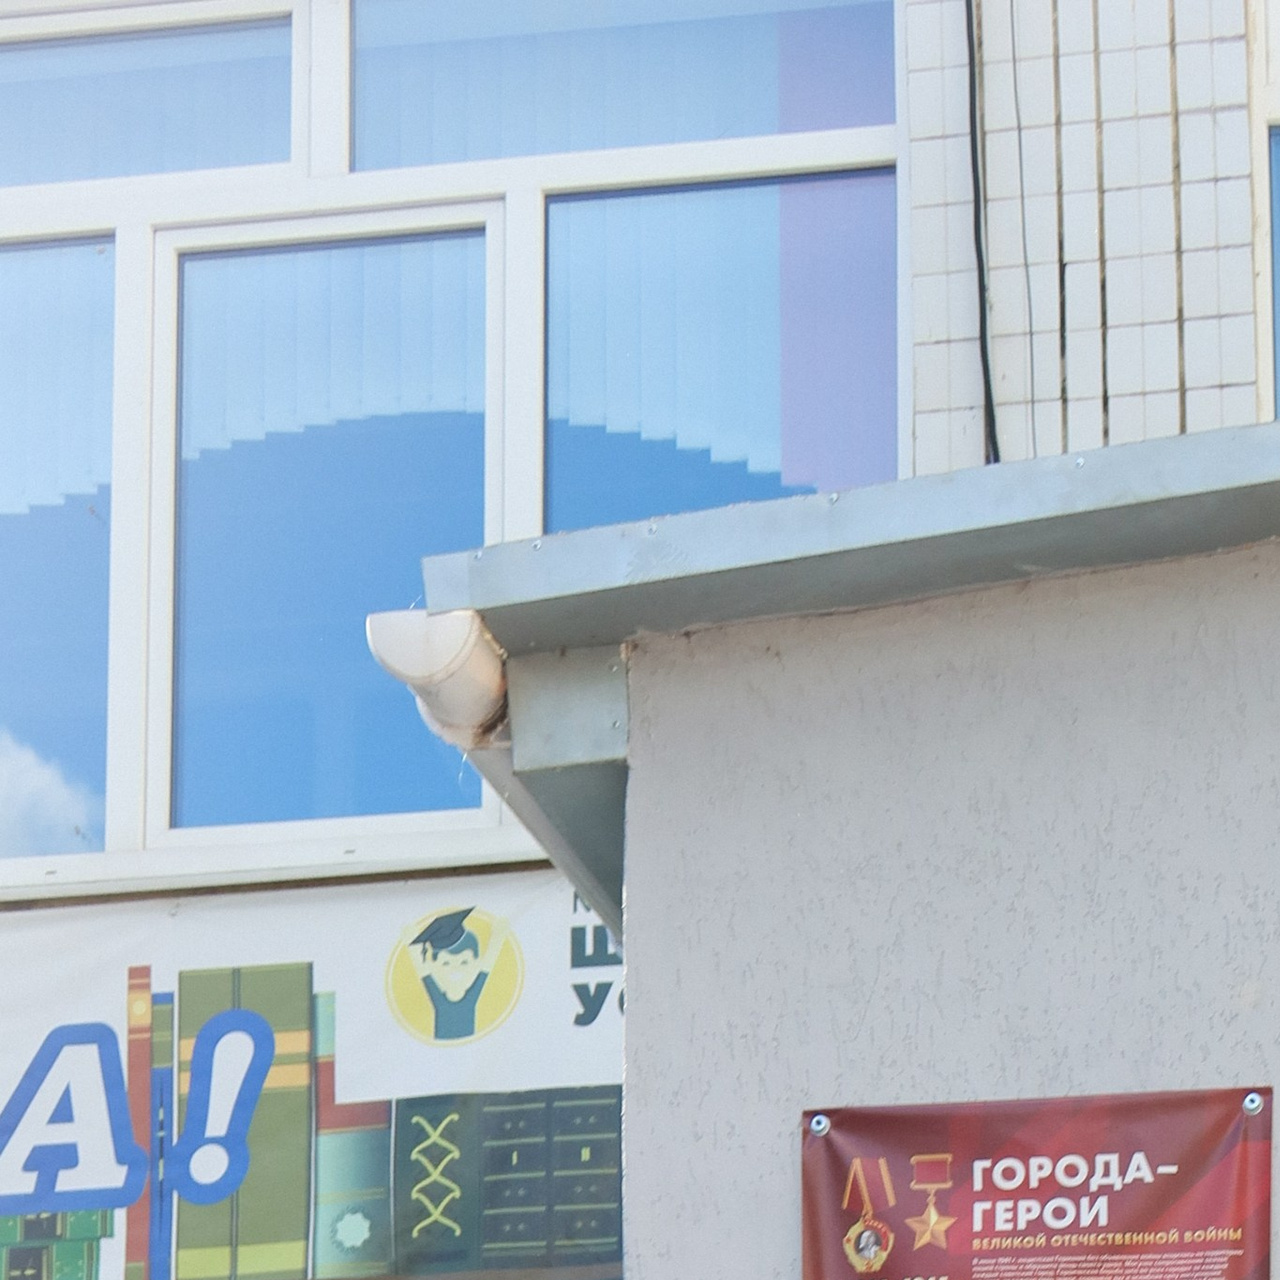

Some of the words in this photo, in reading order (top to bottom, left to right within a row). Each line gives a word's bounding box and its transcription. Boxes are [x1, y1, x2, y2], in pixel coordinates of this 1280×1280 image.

[570, 981, 625, 1027] У
[971, 1151, 1180, 1193] ГОРОДА-
[971, 1194, 1110, 1233] ГЕРОИ
[972, 1232, 1047, 1251] ВЕЛИКОЙ
[1050, 1227, 1180, 1247] ОТЕЧЕСТВЕННОЙ
[1183, 1225, 1243, 1244] ВОЙНЫ
